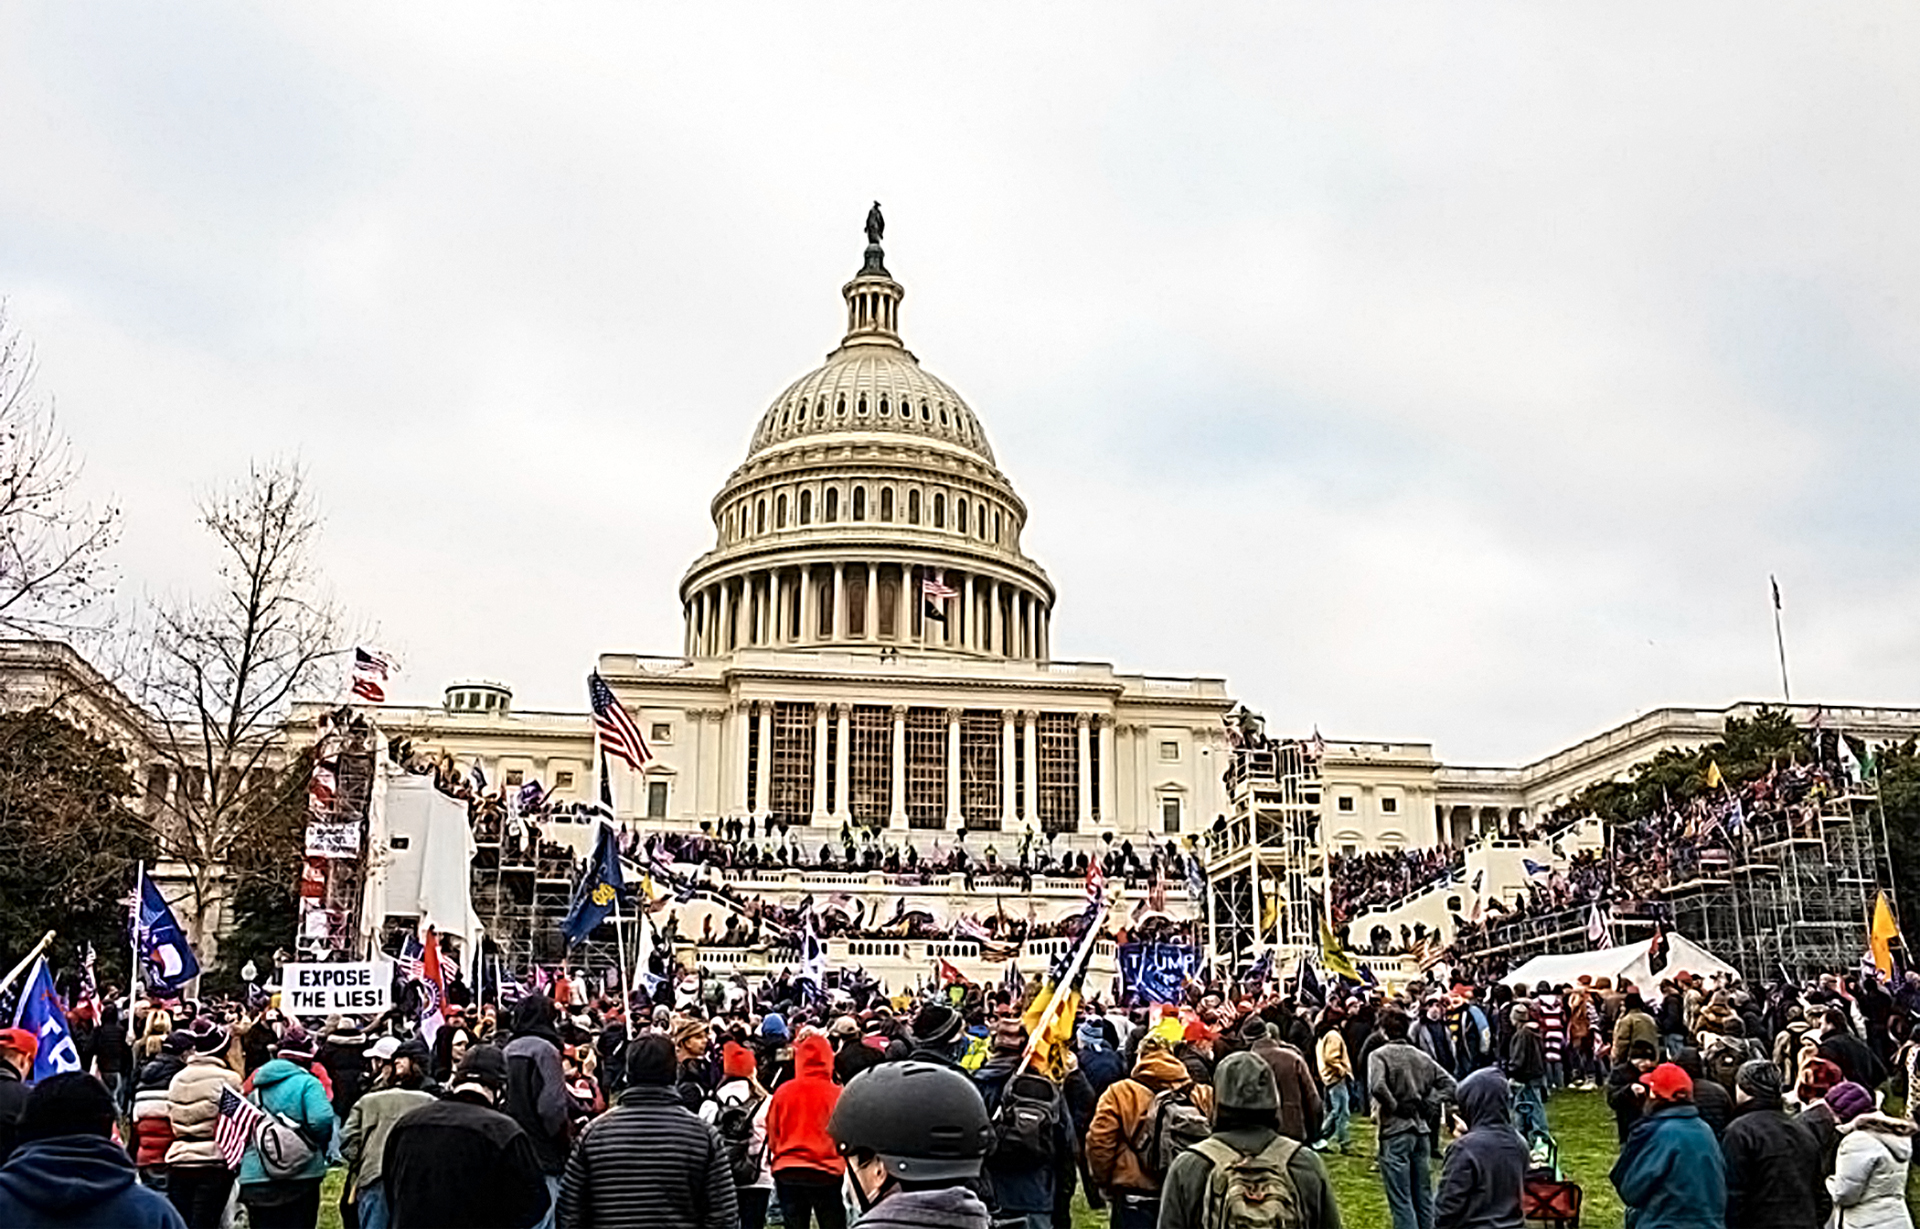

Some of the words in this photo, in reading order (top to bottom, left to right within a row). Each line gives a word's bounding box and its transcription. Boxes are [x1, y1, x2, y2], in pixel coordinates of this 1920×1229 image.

[1128, 953, 1194, 975] TUMP
[299, 969, 371, 987] EXPOSE
[291, 991, 326, 1008] THE
[334, 989, 383, 1007] LIES!
